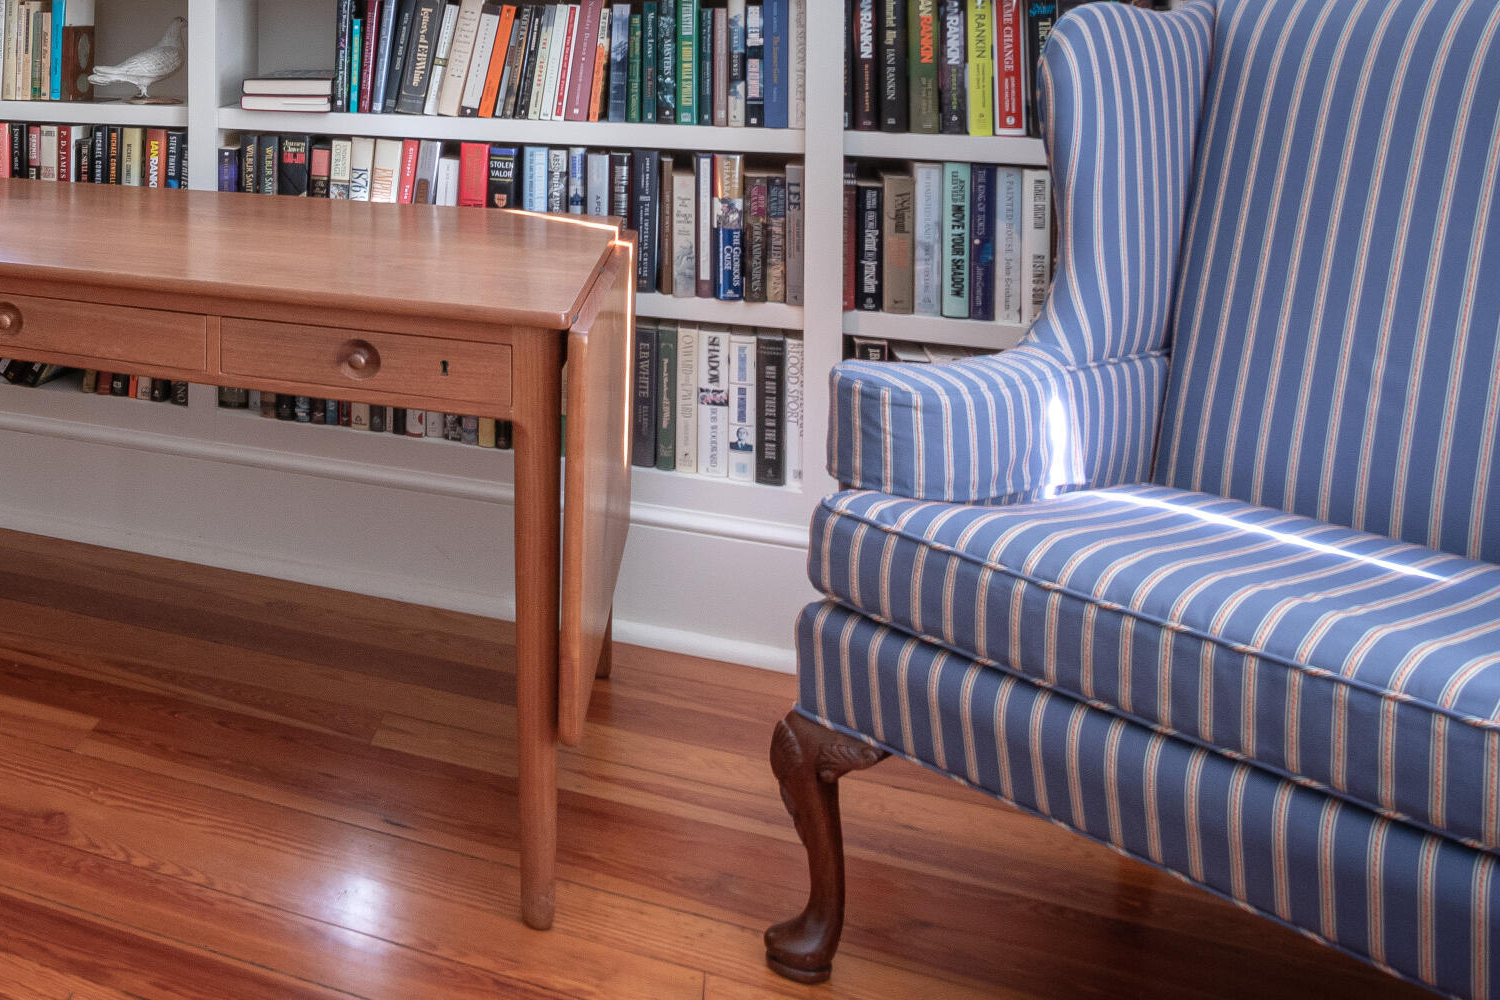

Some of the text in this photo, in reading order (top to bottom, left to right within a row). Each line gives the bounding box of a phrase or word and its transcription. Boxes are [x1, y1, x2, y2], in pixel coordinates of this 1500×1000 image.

[419, 34, 429, 43] of
[518, 8, 531, 41] EMBERS
[860, 14, 872, 59] RANKIN
[884, 30, 896, 45] Alley
[920, 16, 933, 63] RANKIN
[947, 16, 960, 65] RANKIN
[975, 14, 986, 59] RANKIN
[582, 33, 591, 56] Demon
[663, 39, 672, 76] MASTERS
[682, 47, 693, 62] GOOD
[886, 48, 896, 64] IAN
[1003, 26, 1014, 71] CHANGE
[395, 57, 404, 71] DOGS
[682, 63, 693, 80] WALK
[337, 70, 345, 99] Kingsolver
[796, 69, 805, 102] TICKET
[886, 66, 896, 100] RANKIN
[150, 141, 159, 159] IAN
[168, 136, 177, 176] STEVE THAYER
[334, 144, 342, 177] COURAGE
[490, 160, 514, 169] STOLEN
[352, 167, 369, 193] 1876
[490, 170, 514, 179] VALOR
[751, 187, 759, 216] SHAARA
[788, 183, 802, 212] LEE
[977, 170, 985, 236] THE KING OF TORTS
[1006, 180, 1014, 221] PAINTED
[752, 244, 761, 257] AND
[952, 204, 965, 298] MOVE YOUR SHADOW
[1006, 223, 1014, 253] HOUSE
[1032, 179, 1046, 306] MICHAEL CRICHTON RISING SUN
[724, 246, 733, 270] CAUSE
[733, 247, 742, 287] GLORIOUS
[861, 229, 879, 294] Beirut Jerusalem
[1005, 257, 1013, 276] John
[752, 258, 761, 292] GENERALS
[1004, 278, 1013, 311] Grisham
[681, 335, 694, 376] ONWARD
[708, 336, 720, 387] SHADOW
[788, 343, 799, 426] BLOOD SPORT
[765, 365, 777, 460] WAY OUT THERE IN THE BLUE
[710, 407, 718, 468] BOB WOODWARD
